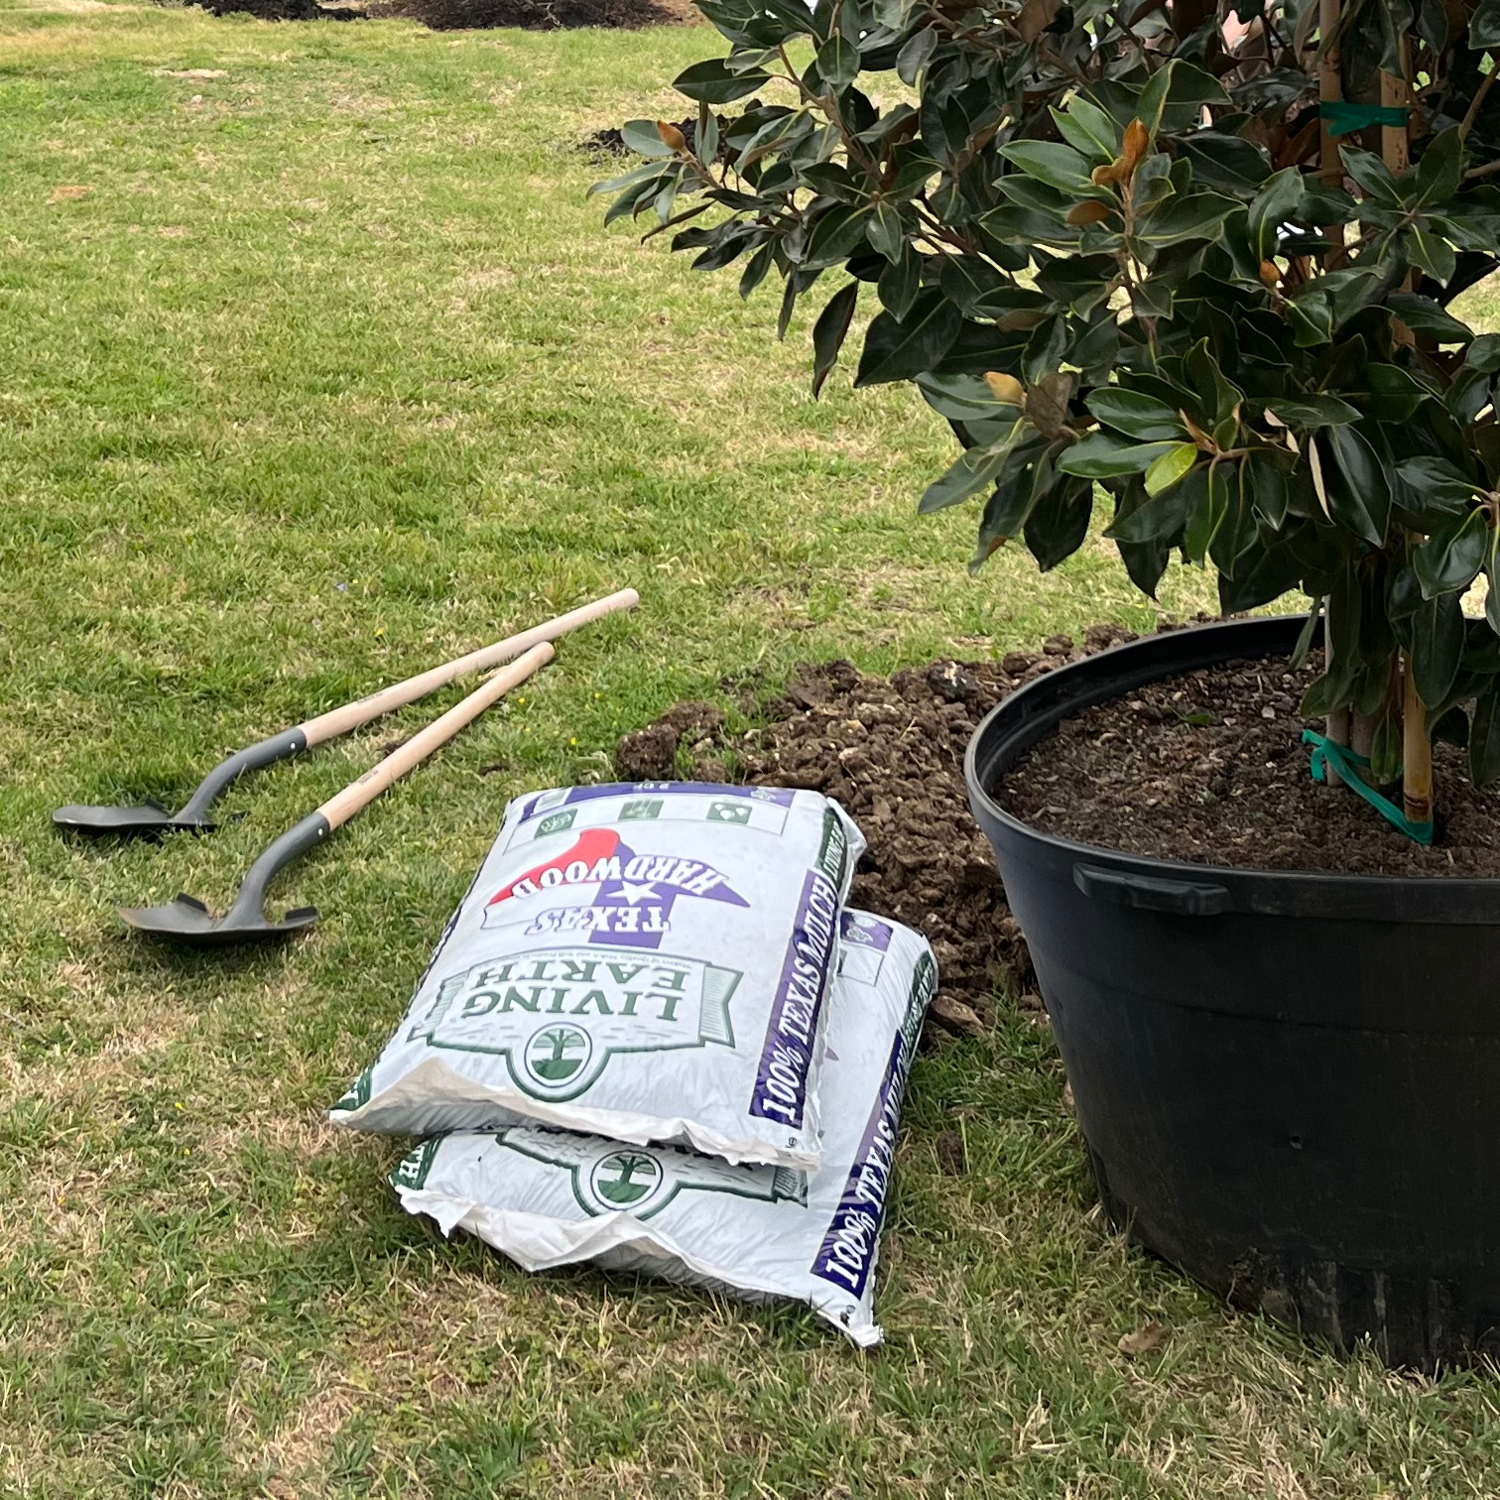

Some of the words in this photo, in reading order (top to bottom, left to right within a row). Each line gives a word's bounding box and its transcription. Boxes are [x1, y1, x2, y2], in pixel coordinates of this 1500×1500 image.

[511, 855, 729, 899] HARDWOOD
[524, 905, 672, 936] TEXAS
[798, 875, 837, 967] MULCH
[461, 985, 683, 1022] LIVING
[471, 959, 691, 992] EARTH
[778, 957, 822, 1046] TEXAS
[763, 1041, 805, 1122] 100%
[825, 1206, 876, 1290] 100%
[855, 1118, 896, 1215] TEXAS
